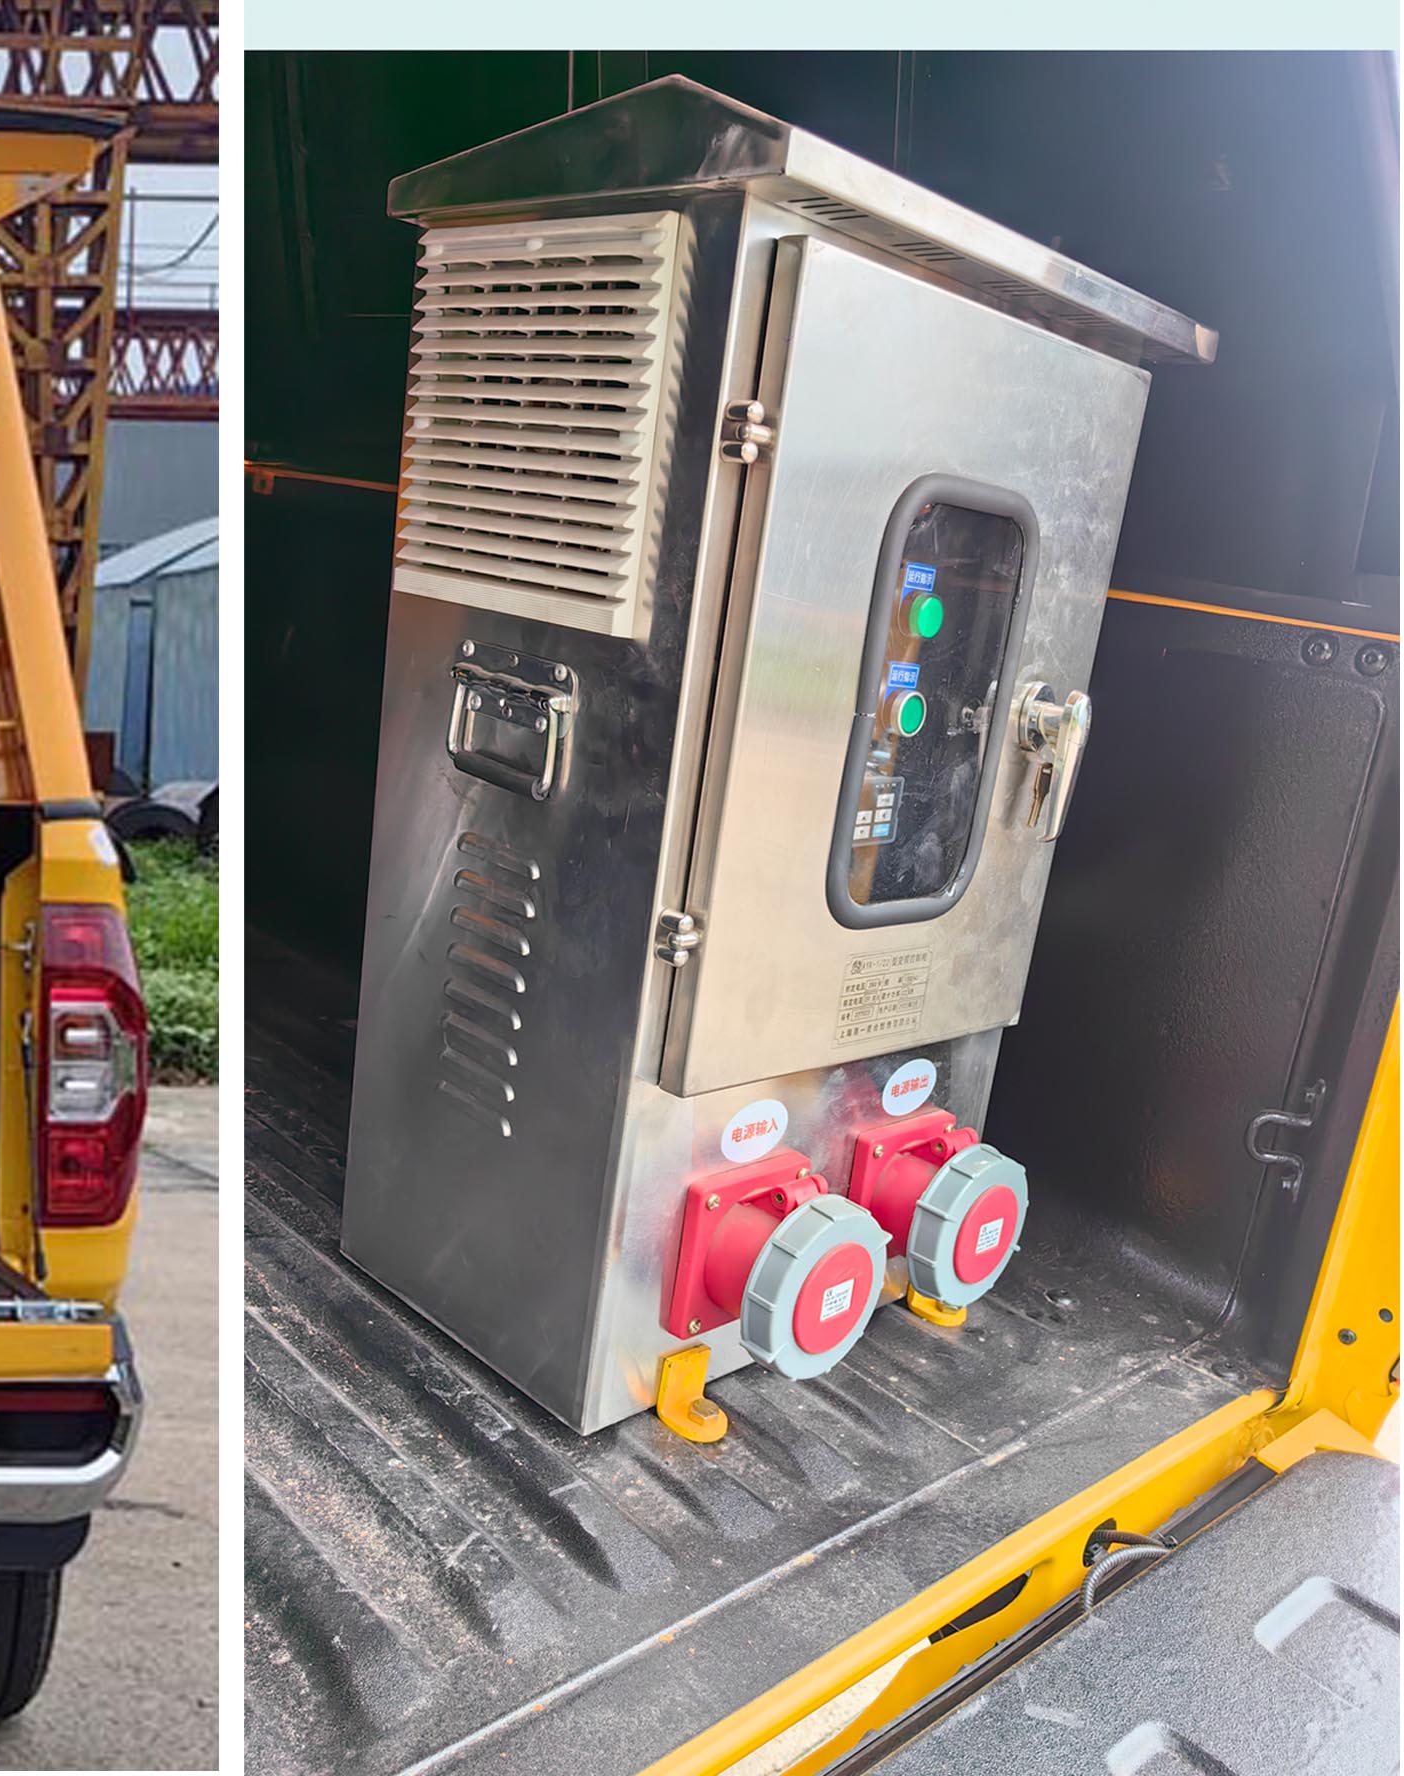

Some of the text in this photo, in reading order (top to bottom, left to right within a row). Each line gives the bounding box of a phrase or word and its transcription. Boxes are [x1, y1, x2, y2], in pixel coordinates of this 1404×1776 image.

[891, 1074, 929, 1097] 电源输出
[731, 1118, 778, 1143] 电源输入
